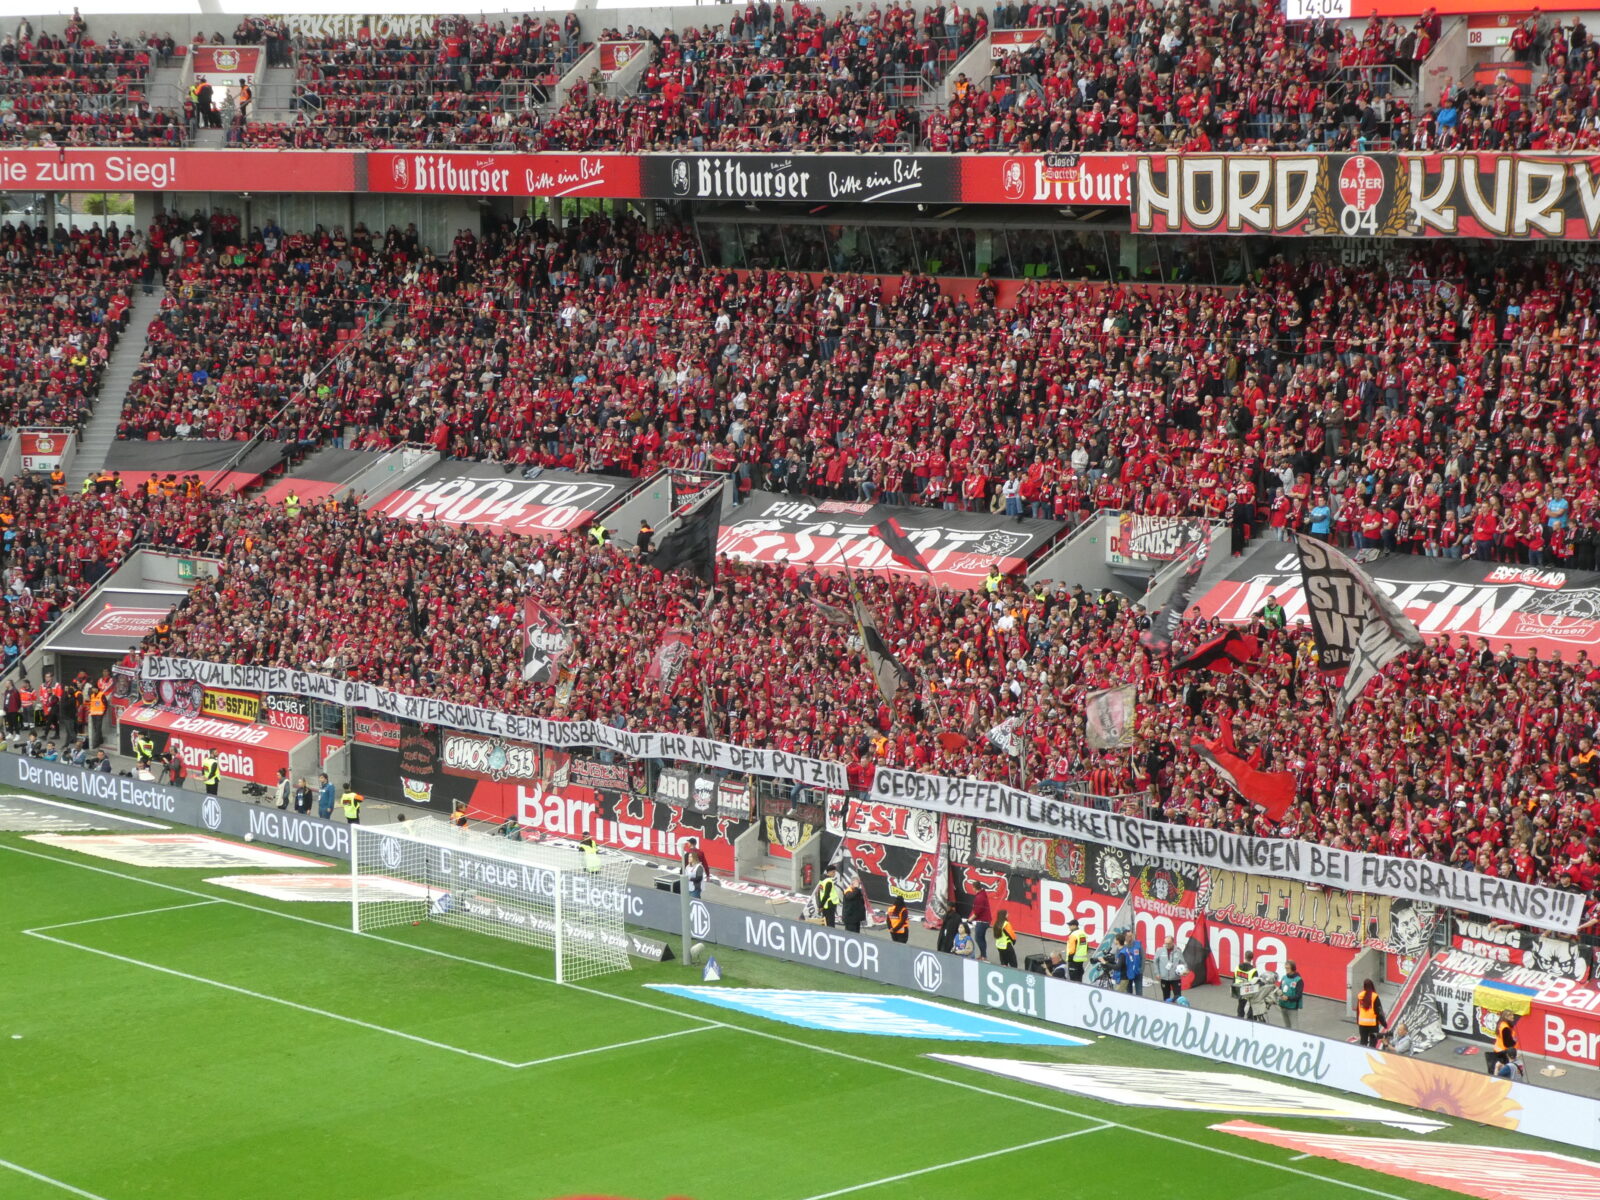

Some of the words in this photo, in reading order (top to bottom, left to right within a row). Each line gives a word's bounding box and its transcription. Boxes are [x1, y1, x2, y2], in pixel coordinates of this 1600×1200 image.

[1298, 0, 1344, 14] 14:04
[1469, 31, 1482, 43] D8
[37, 163, 95, 182] zum
[105, 156, 176, 188] Sieg!
[415, 155, 510, 193] Bitburger
[526, 168, 555, 194] Bitte
[558, 169, 579, 186] ein
[1047, 155, 1085, 168] Closed
[697, 158, 810, 198] Bitburger
[829, 171, 862, 198] Bitte
[866, 171, 891, 188] ein
[1340, 177, 1382, 190] BAYER
[1138, 156, 1319, 230] NORD
[1340, 204, 1379, 236] 04
[760, 501, 816, 521] FÜR
[1534, 570, 1567, 586] LAND
[1520, 624, 1587, 636] Leverkusen
[149, 656, 171, 678] BEI
[172, 658, 287, 689] SEXUALISIERTER
[291, 672, 339, 697] GEWALT
[344, 682, 370, 703] GILT
[377, 688, 400, 713] DER
[506, 715, 542, 738] BEIM
[548, 722, 615, 746] FUSSBALL
[615, 731, 654, 755] HAUT
[660, 733, 687, 758] IHR
[691, 739, 722, 762] AUF
[730, 745, 765, 771] DEN
[266, 695, 306, 715] Bayer
[170, 716, 269, 745] Barmenia
[444, 736, 492, 773] CHAOS
[18, 758, 43, 783] Der
[45, 769, 79, 793] neue
[81, 772, 118, 801] MG4
[120, 780, 175, 814] Electric
[659, 774, 689, 800] BRO
[249, 808, 280, 837] MG
[282, 814, 349, 854] MOTOR
[877, 772, 941, 801] GEGEN
[1311, 852, 1350, 880] BEI
[949, 849, 971, 864] OYZ
[1163, 858, 1198, 881] BOYZ
[477, 861, 518, 888] neue
[572, 875, 644, 918] Electric
[503, 909, 525, 924] trive
[1133, 895, 1195, 922] EVERKUSEN
[536, 917, 556, 932] triv
[1215, 903, 1326, 944] Ausgesperrte
[1329, 932, 1356, 949] mit
[641, 941, 662, 957] trive
[746, 915, 785, 952] MG
[790, 923, 879, 973] MOTOR
[986, 972, 1038, 1016] Sai
[1436, 985, 1454, 999] MIR
[1454, 988, 1473, 1003] AUF
[1082, 989, 1331, 1081] Sonnenblumenöl
